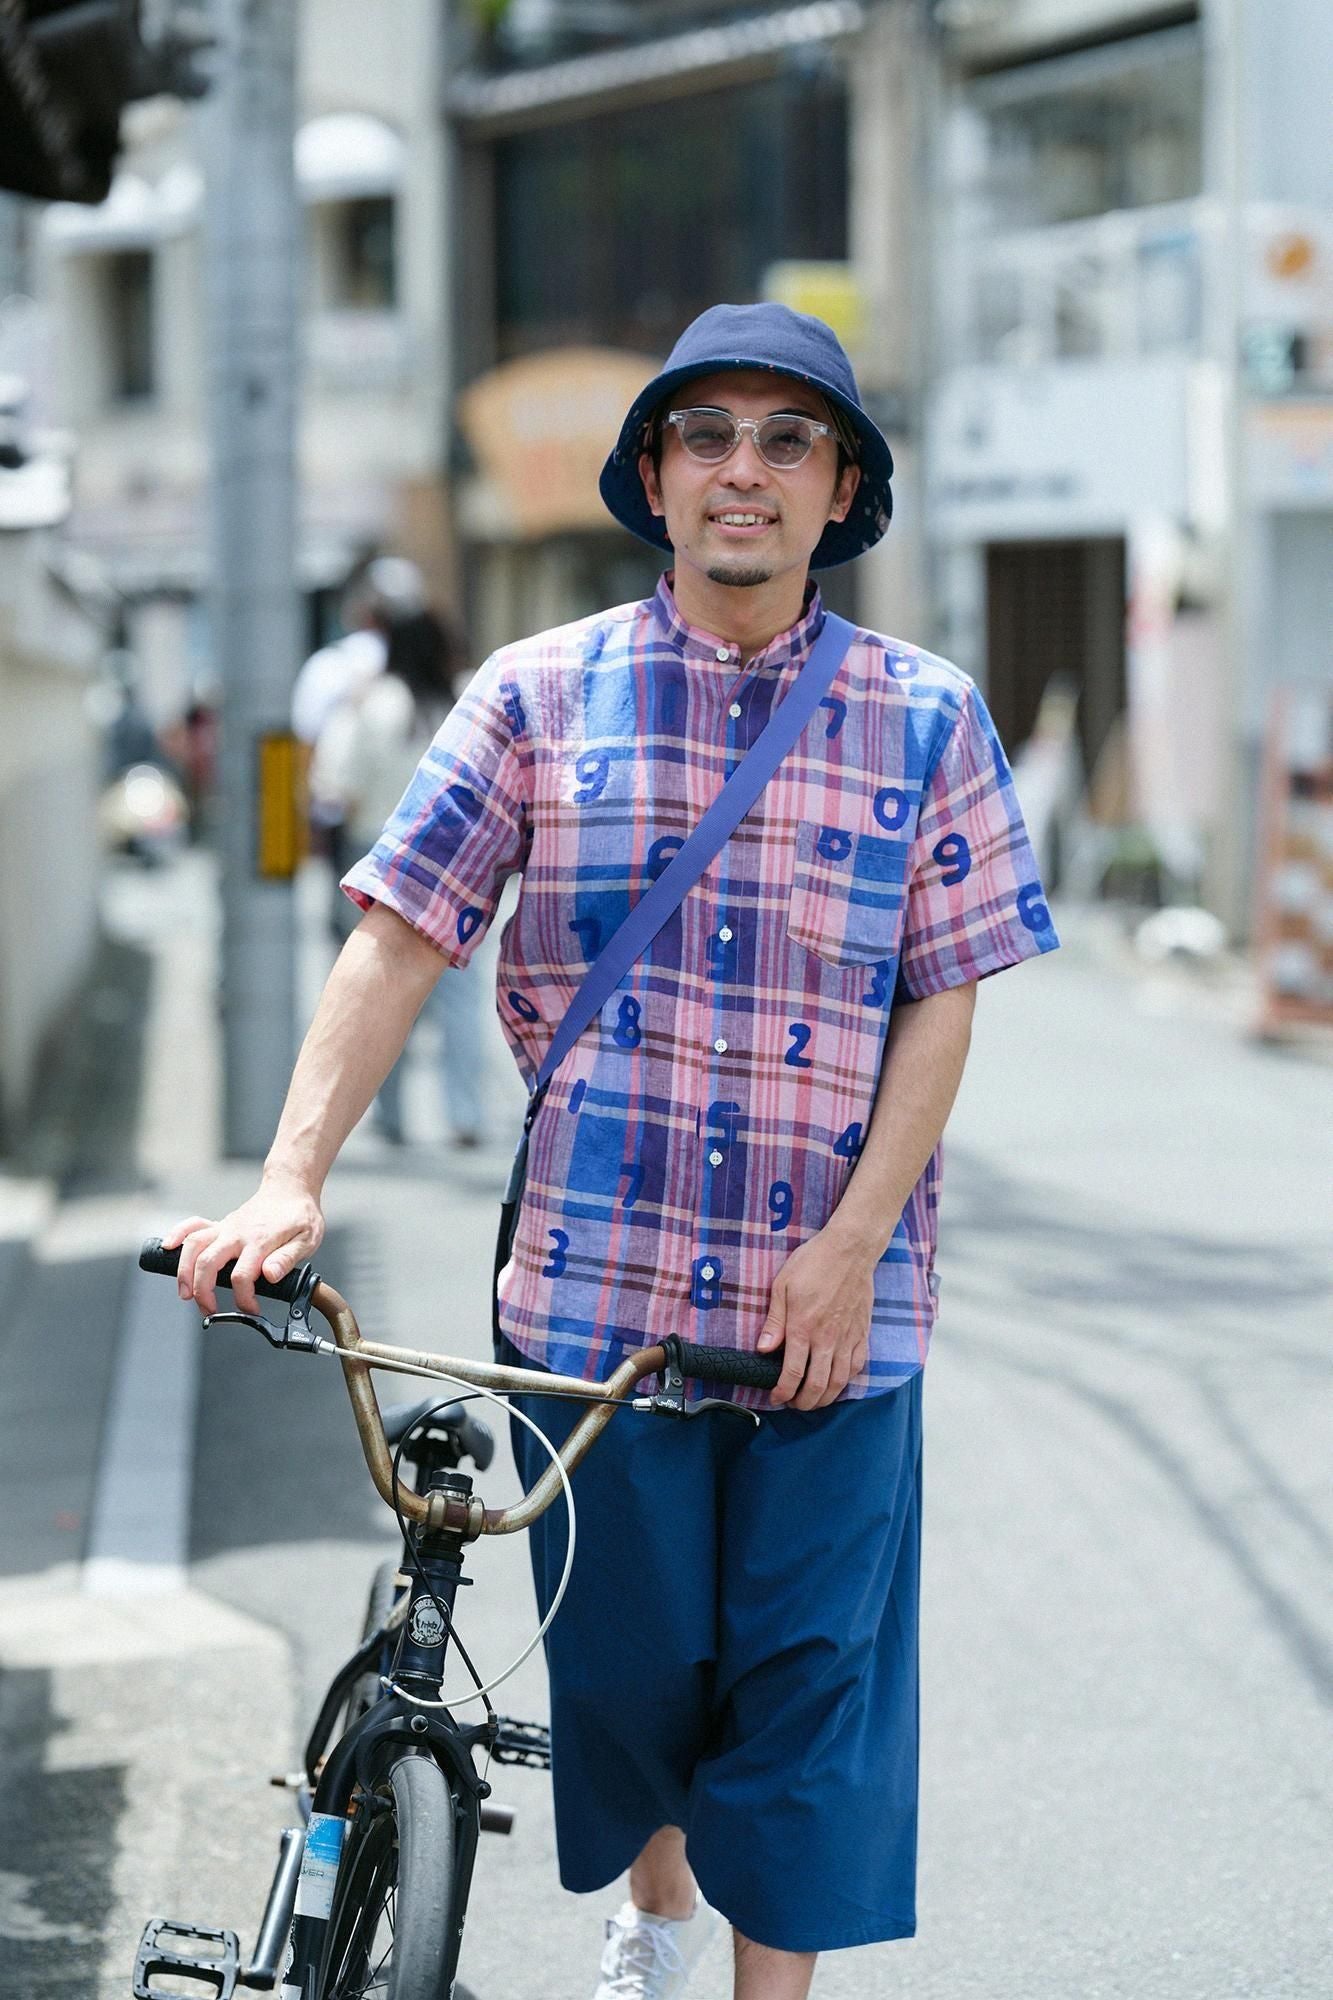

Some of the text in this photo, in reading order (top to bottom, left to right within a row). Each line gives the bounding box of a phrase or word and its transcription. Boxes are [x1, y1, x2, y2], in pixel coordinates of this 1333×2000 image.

[574, 750, 610, 803] 9
[873, 787, 910, 831] 0
[932, 832, 972, 887] 9
[1016, 882, 1051, 932] 6
[862, 959, 889, 1007] 3
[612, 995, 642, 1049] 8
[784, 1023, 812, 1068] 2
[567, 1078, 587, 1114] 1
[706, 1101, 741, 1150] 5
[833, 1122, 863, 1167] 4
[619, 1162, 646, 1208] 7
[768, 1181, 794, 1232] 9
[542, 1228, 570, 1279] 3
[690, 1256, 724, 1311] 8
